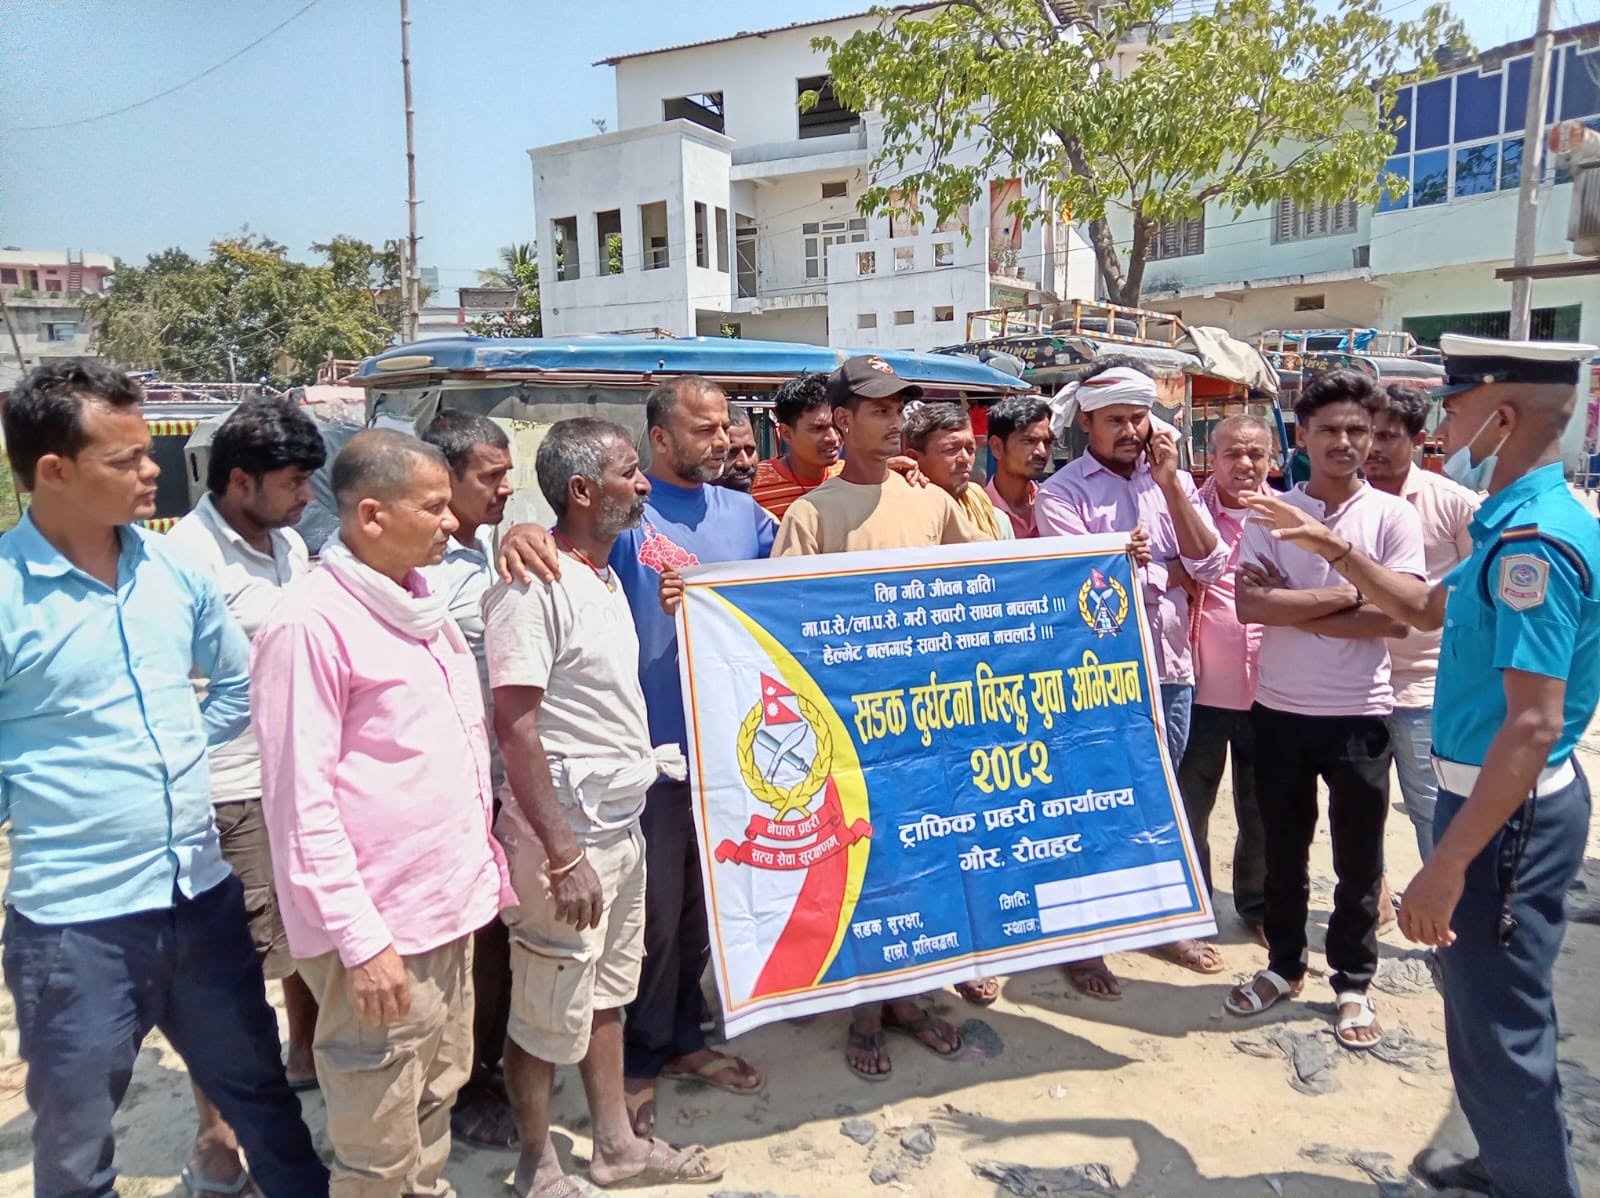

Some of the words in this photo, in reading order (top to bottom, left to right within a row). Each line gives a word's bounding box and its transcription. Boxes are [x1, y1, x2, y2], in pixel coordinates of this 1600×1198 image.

[901, 579, 926, 600] गति
[928, 578, 963, 598] जीवन
[903, 606, 927, 627] गरी
[930, 602, 966, 625] सवारी
[968, 603, 1003, 621] साधन
[822, 641, 863, 666] हेल्मेट
[865, 636, 914, 657] नलगाई
[916, 631, 953, 655] सवारी
[955, 631, 990, 650] साधन
[851, 688, 907, 745] सडक
[909, 671, 975, 747] दुर्घटना
[1029, 669, 1066, 730] युवा
[1069, 649, 1143, 711] अभियान
[970, 740, 1054, 794] २०८२
[766, 822, 796, 837] नेपाल
[798, 814, 820, 834] प्रहरी
[898, 813, 977, 849] ट्राफिक
[983, 798, 1036, 832] प्रहरी
[1042, 787, 1136, 819] कार्यालय
[751, 848, 774, 865] सत्य
[777, 850, 796, 867] सेवा
[1011, 833, 1083, 863] रौतहट
[852, 919, 883, 939] सडक
[882, 938, 909, 963] हाम्रो
